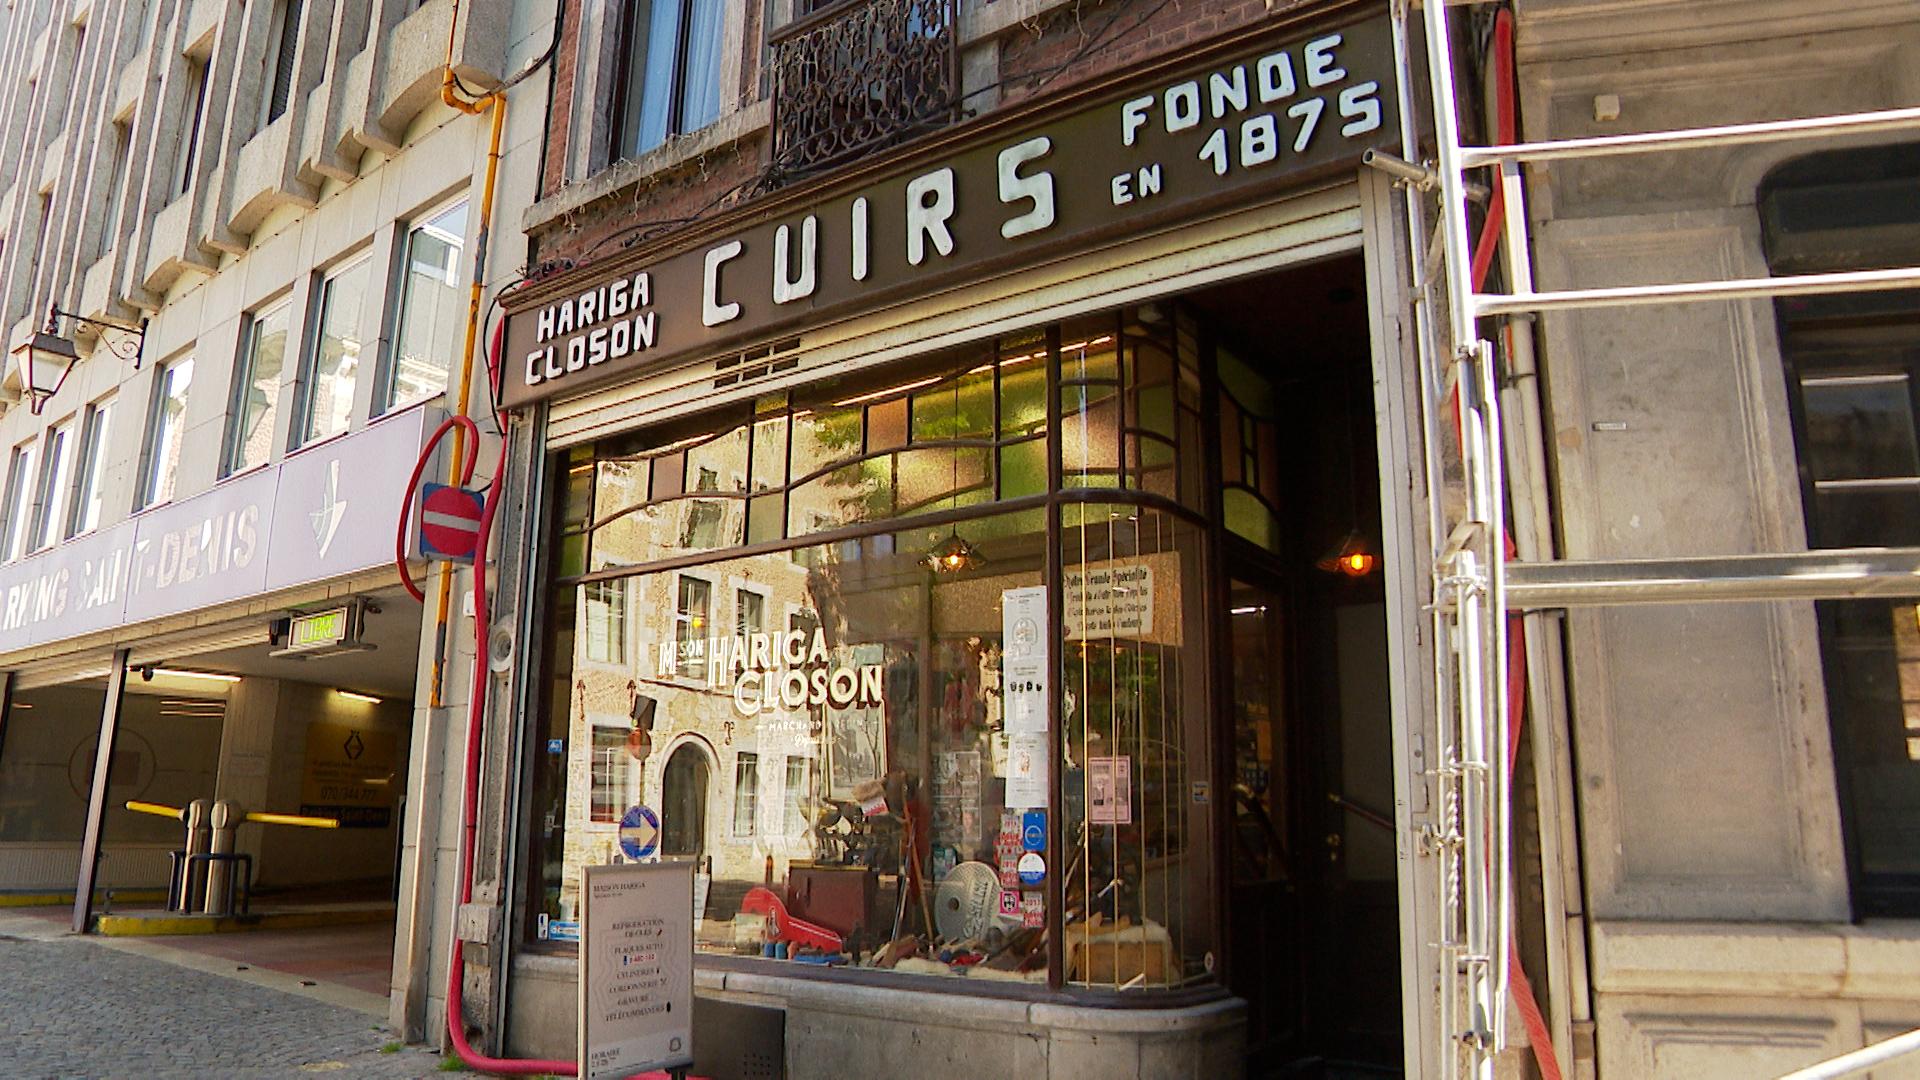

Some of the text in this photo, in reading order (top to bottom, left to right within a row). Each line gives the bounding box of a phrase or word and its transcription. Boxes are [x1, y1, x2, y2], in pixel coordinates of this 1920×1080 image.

[1121, 33, 1347, 147] FONDE
[1111, 80, 1382, 206] EN 1875
[702, 136, 1055, 327] CUIRS
[537, 272, 649, 344] HARIGA
[525, 311, 655, 386] CLOSON
[0, 566, 70, 632] RKING
[301, 613, 337, 643] LIBRE
[707, 627, 829, 687] HARIGA
[734, 664, 883, 716] CLOSON
